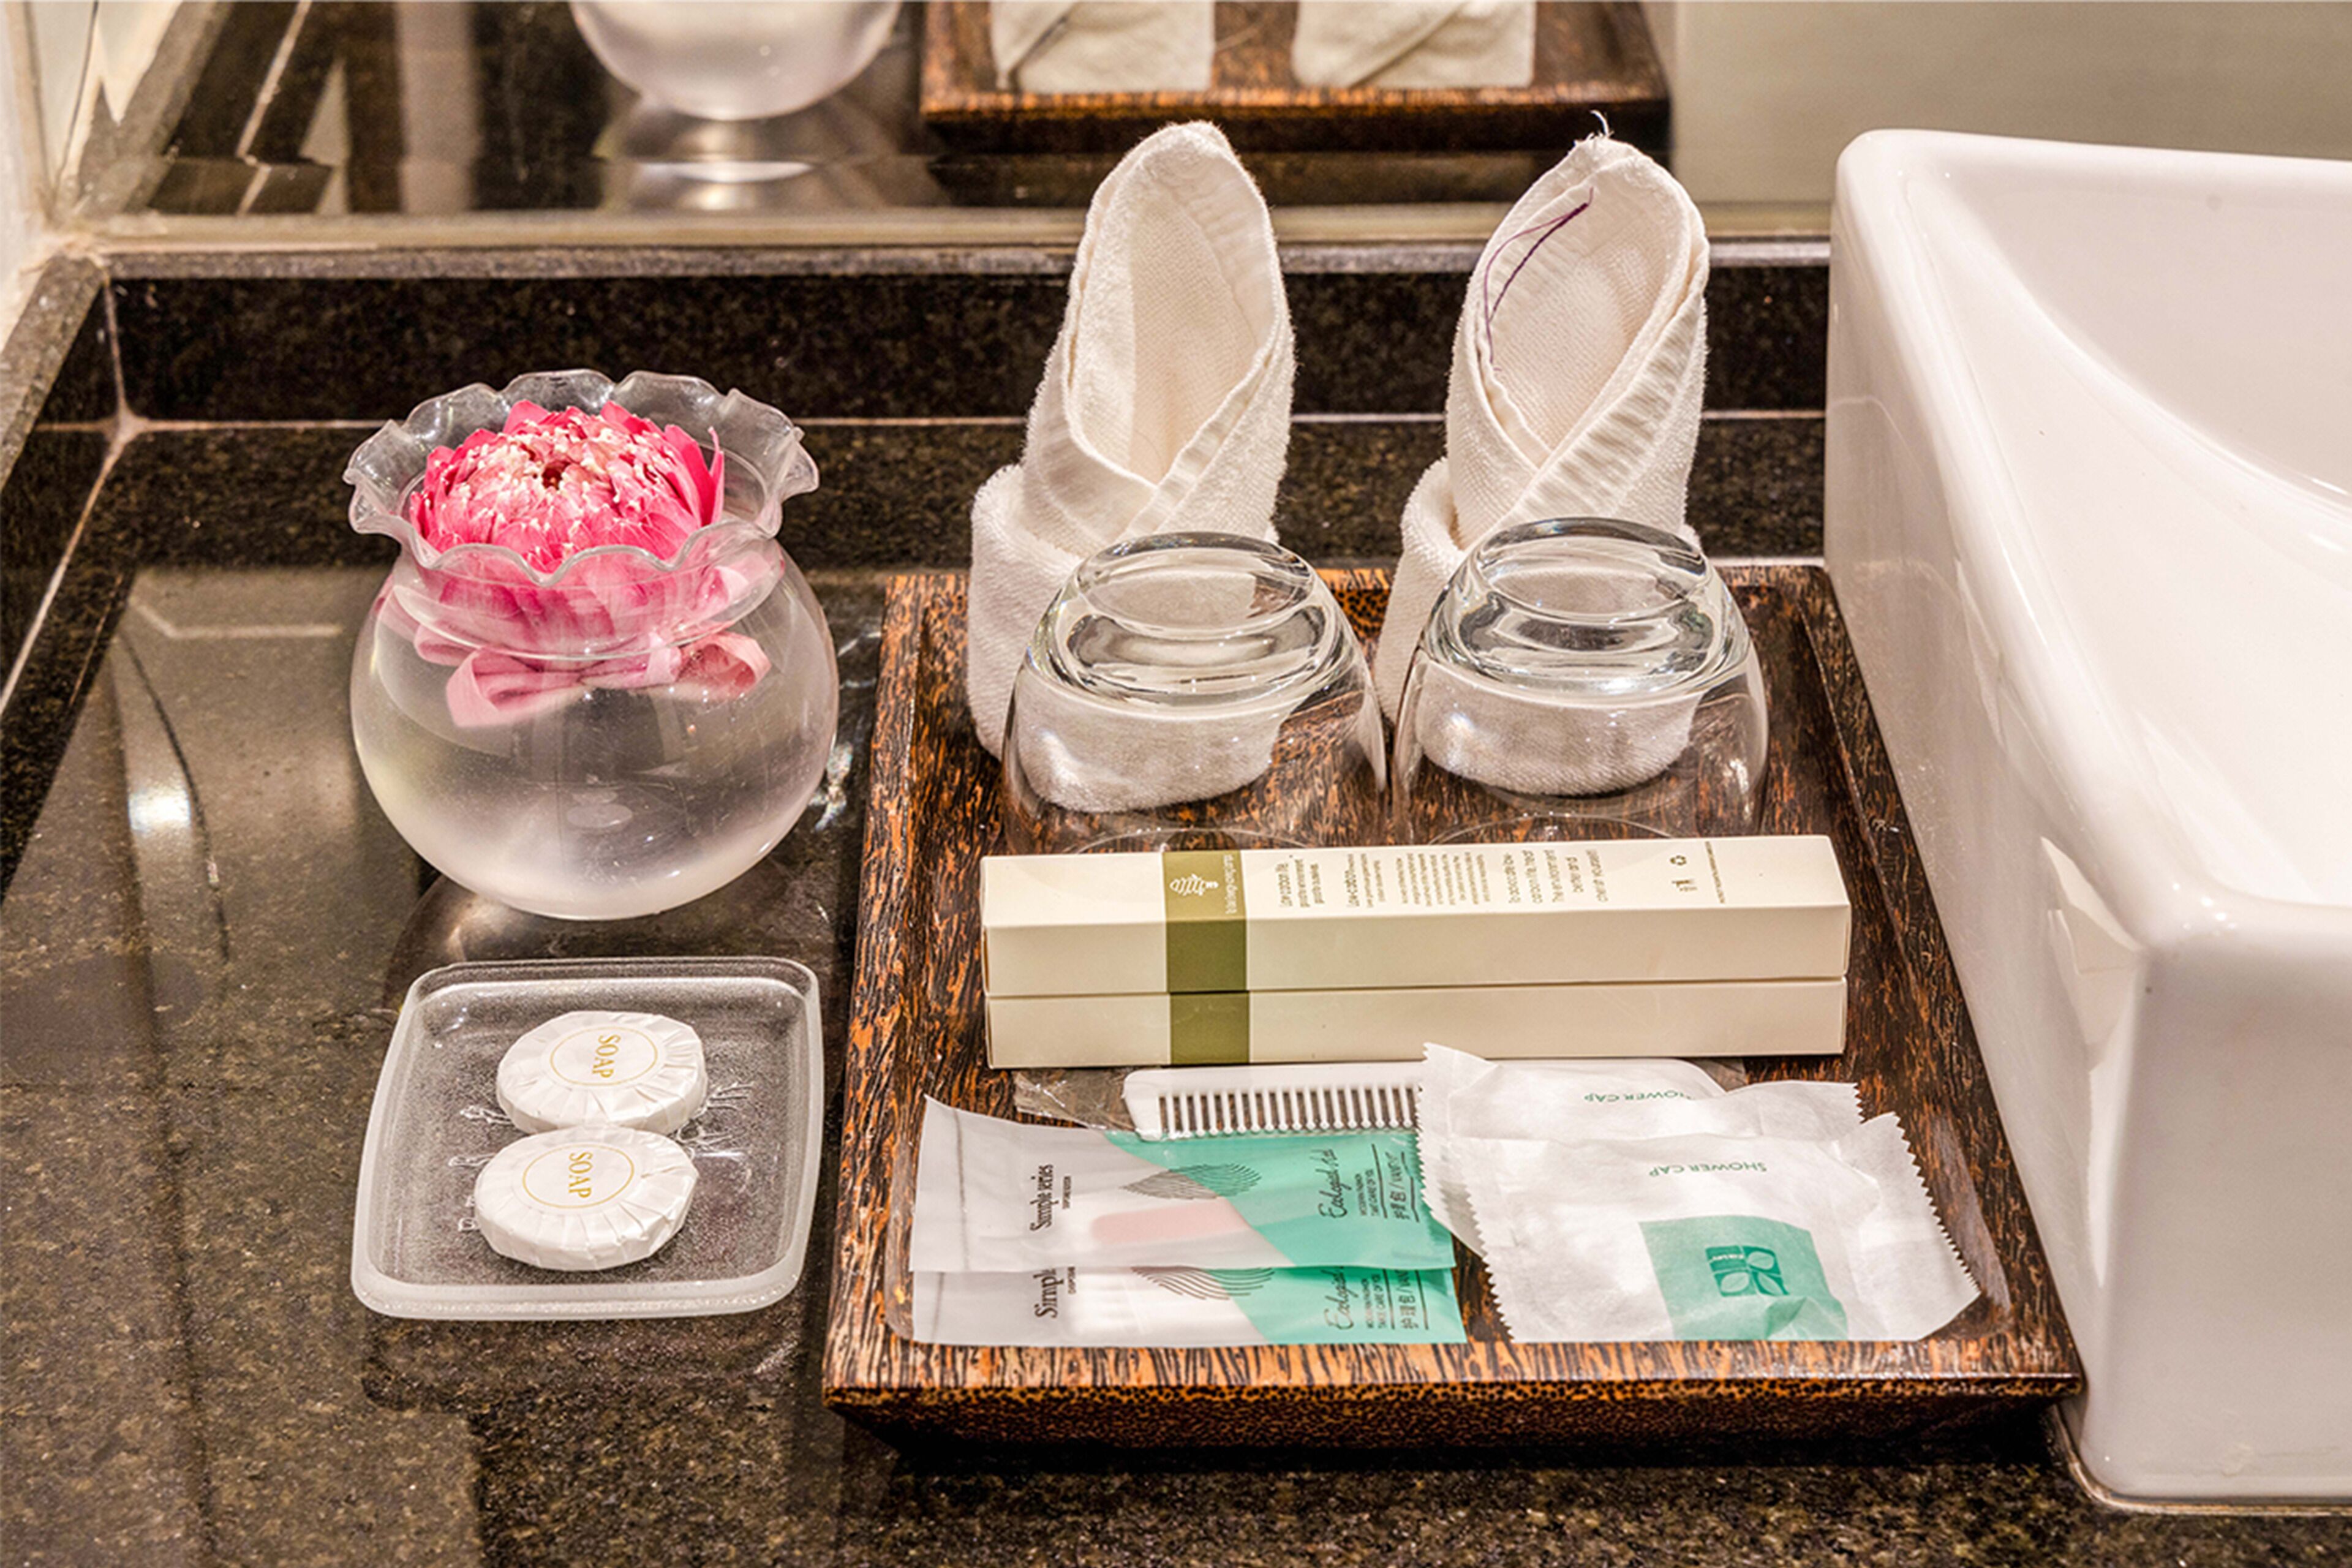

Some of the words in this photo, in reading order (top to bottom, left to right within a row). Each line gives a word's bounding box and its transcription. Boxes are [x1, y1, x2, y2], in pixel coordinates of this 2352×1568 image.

[592, 1035, 622, 1079] SOAP
[1584, 1093, 1620, 1103] CAP
[568, 1152, 594, 1199] SOAP
[1648, 1165, 1685, 1178] CAP
[1688, 1162, 1767, 1172] SHOWER
[1030, 1164, 1054, 1191] series
